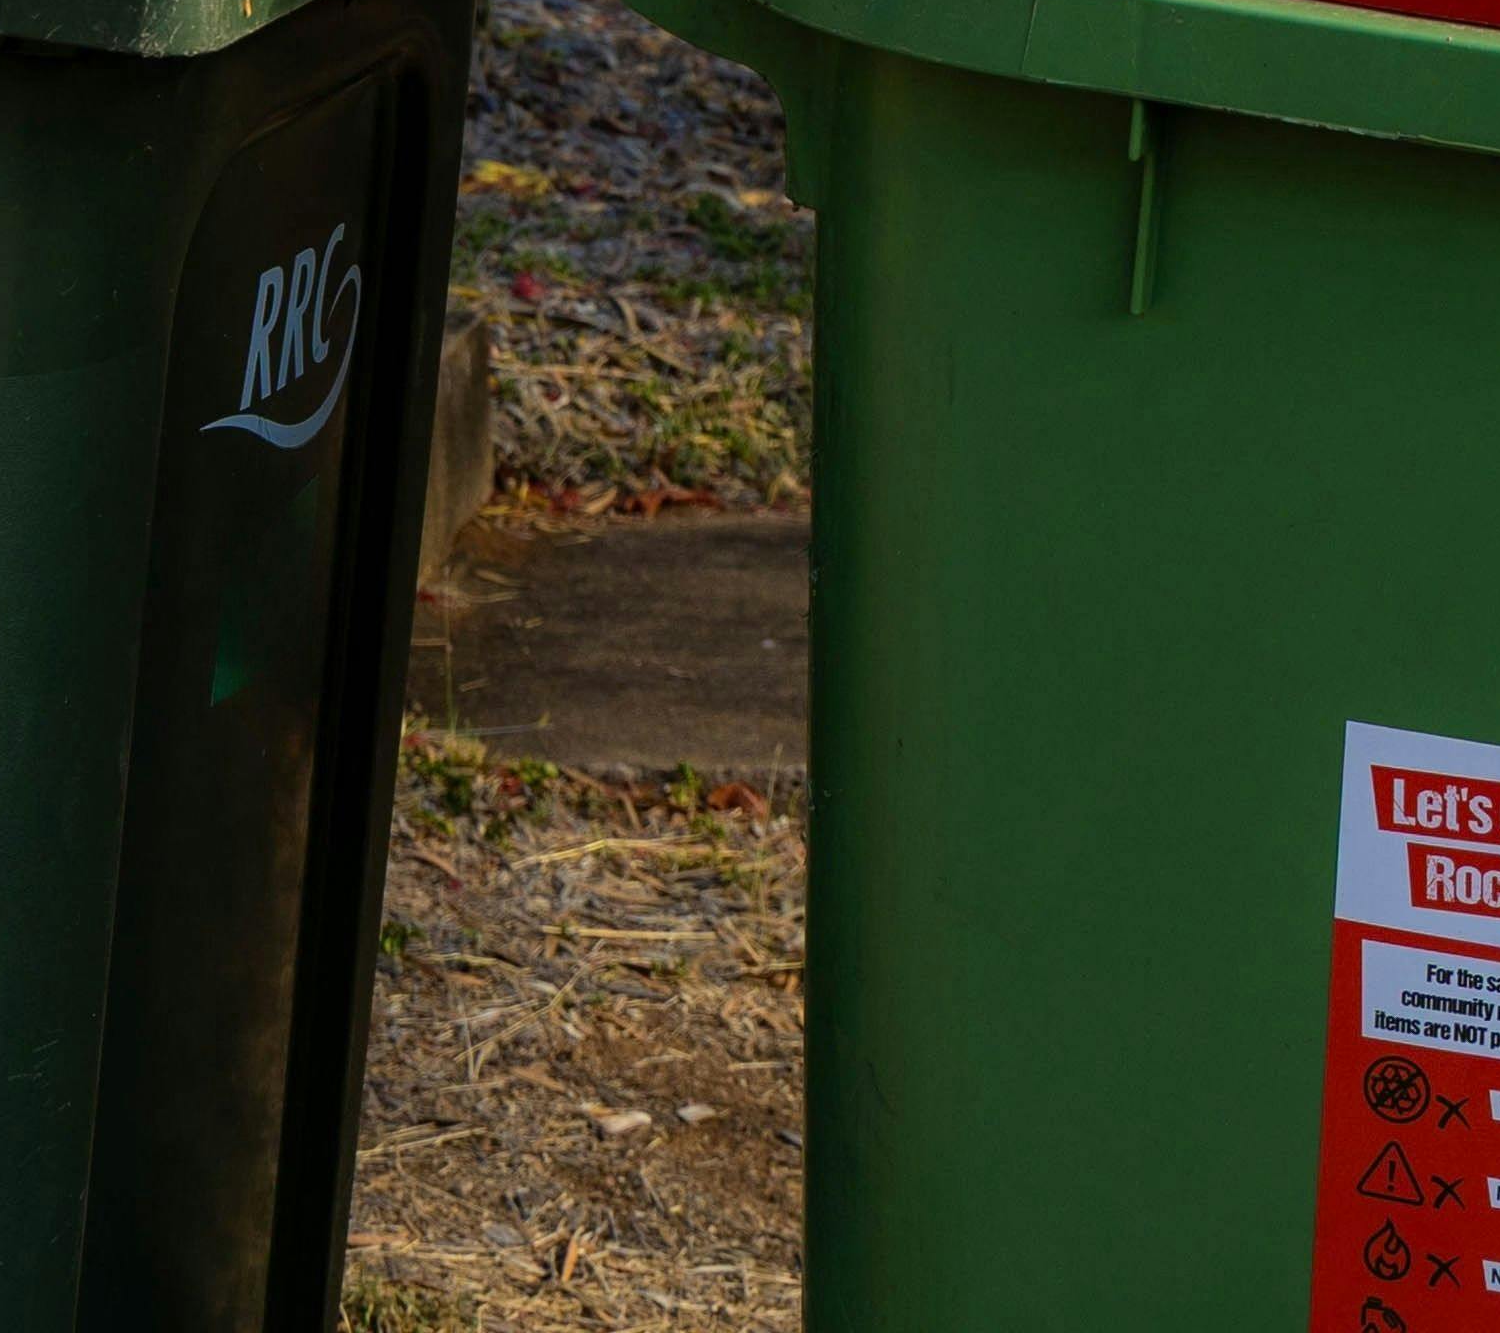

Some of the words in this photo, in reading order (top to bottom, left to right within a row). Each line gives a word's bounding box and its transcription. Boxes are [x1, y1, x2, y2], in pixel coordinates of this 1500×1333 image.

[1393, 778, 1493, 834] Let's
[1426, 963, 1453, 986] For
[1457, 967, 1484, 991] the
[1401, 990, 1494, 1021] community
[1374, 1010, 1421, 1035] items
[1423, 1017, 1451, 1041] are
[1453, 1022, 1487, 1046] NOT
